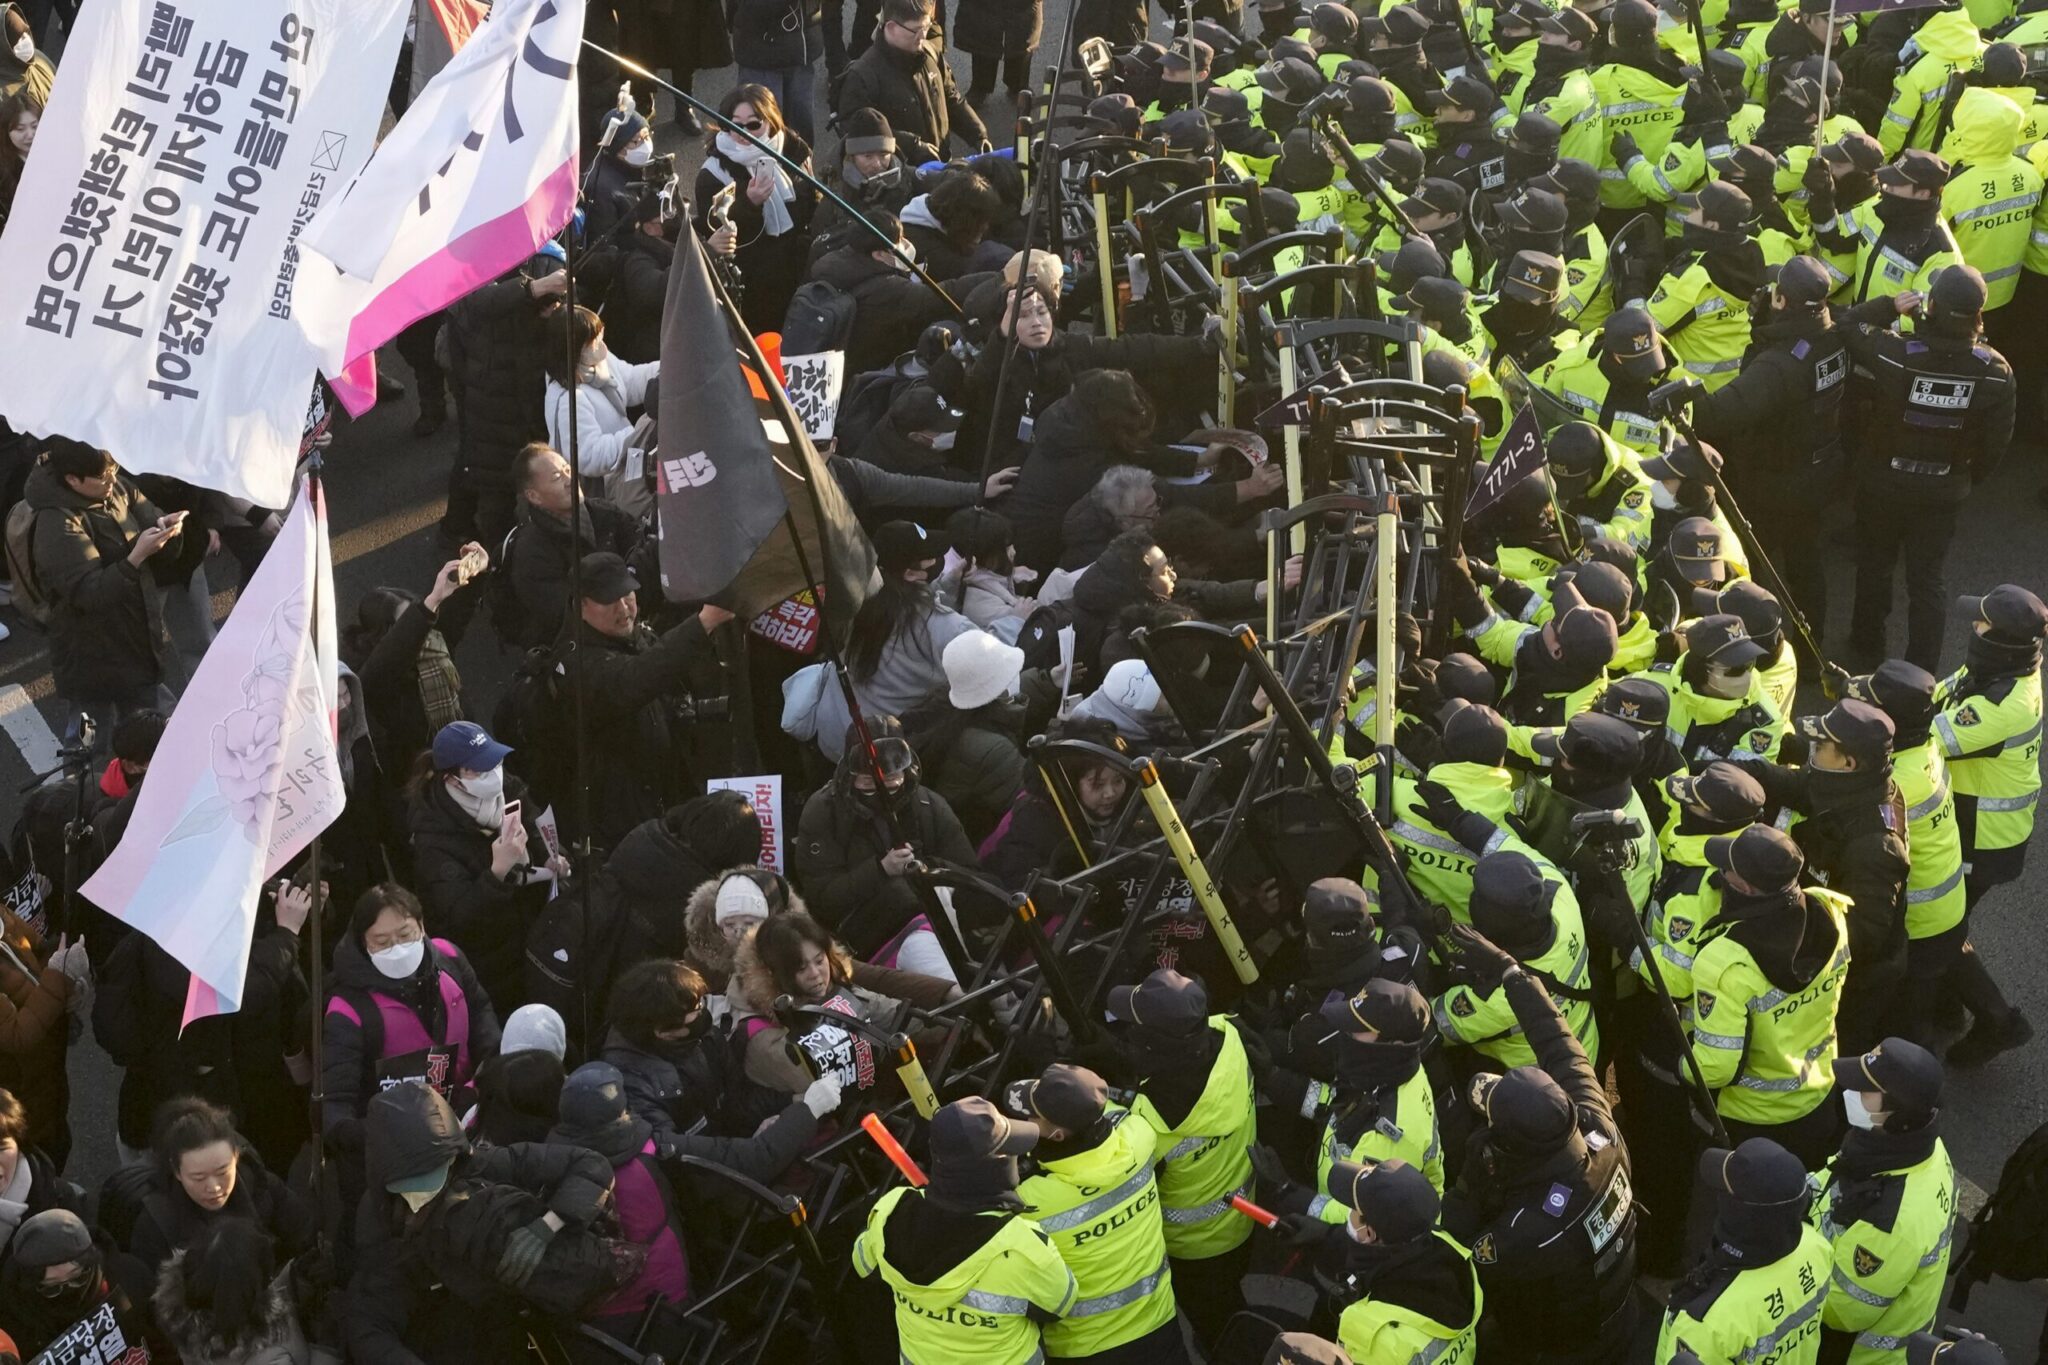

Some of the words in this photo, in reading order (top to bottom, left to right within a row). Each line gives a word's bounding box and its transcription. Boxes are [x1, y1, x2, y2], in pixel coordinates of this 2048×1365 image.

[1609, 111, 1675, 128] POLICE
[1980, 172, 2025, 200] 경찰
[1973, 209, 2033, 231] POLICE
[1917, 393, 1965, 406] POLICE
[1920, 380, 1967, 398] 경찰
[1485, 430, 1537, 497] 77기-3
[778, 600, 816, 626] 즉각
[1331, 929, 1356, 937] POLICE
[1773, 970, 1845, 1025] POLICE
[1072, 1183, 1157, 1246] POLICE
[1598, 1191, 1630, 1241] POLICE
[1763, 1261, 1817, 1320] 경찰
